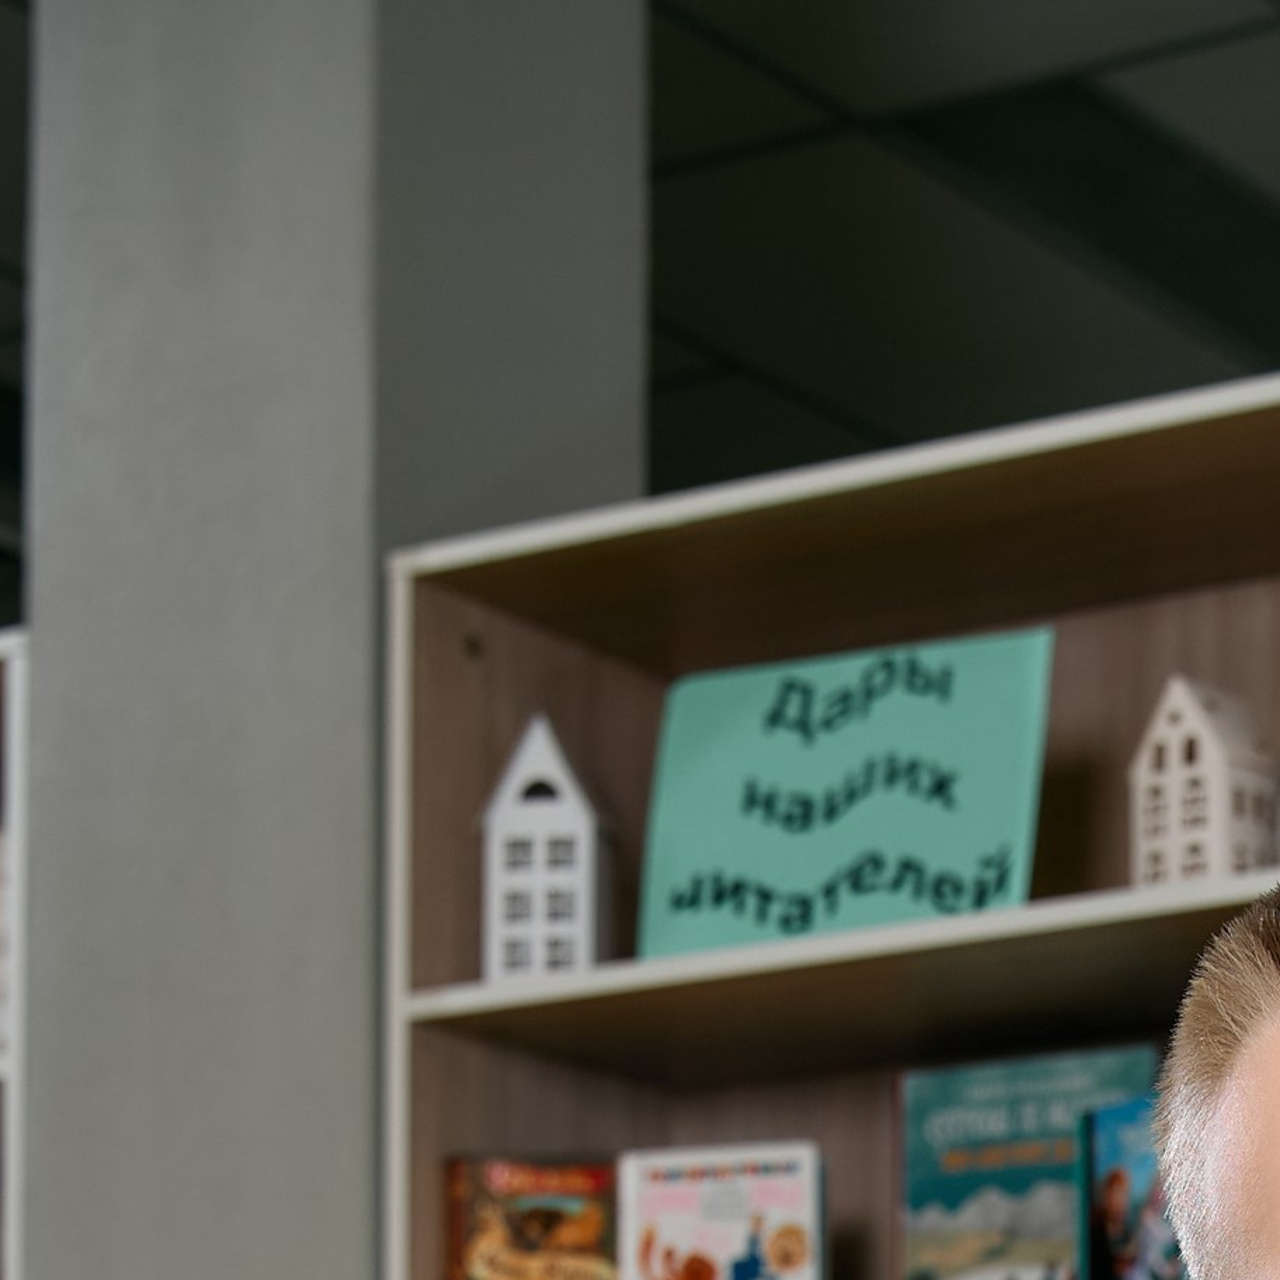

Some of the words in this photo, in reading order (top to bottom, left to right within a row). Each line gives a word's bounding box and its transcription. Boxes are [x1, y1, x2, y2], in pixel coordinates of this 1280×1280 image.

[763, 653, 953, 746] Дары
[740, 752, 958, 834] наших
[669, 845, 1012, 935] читателей
